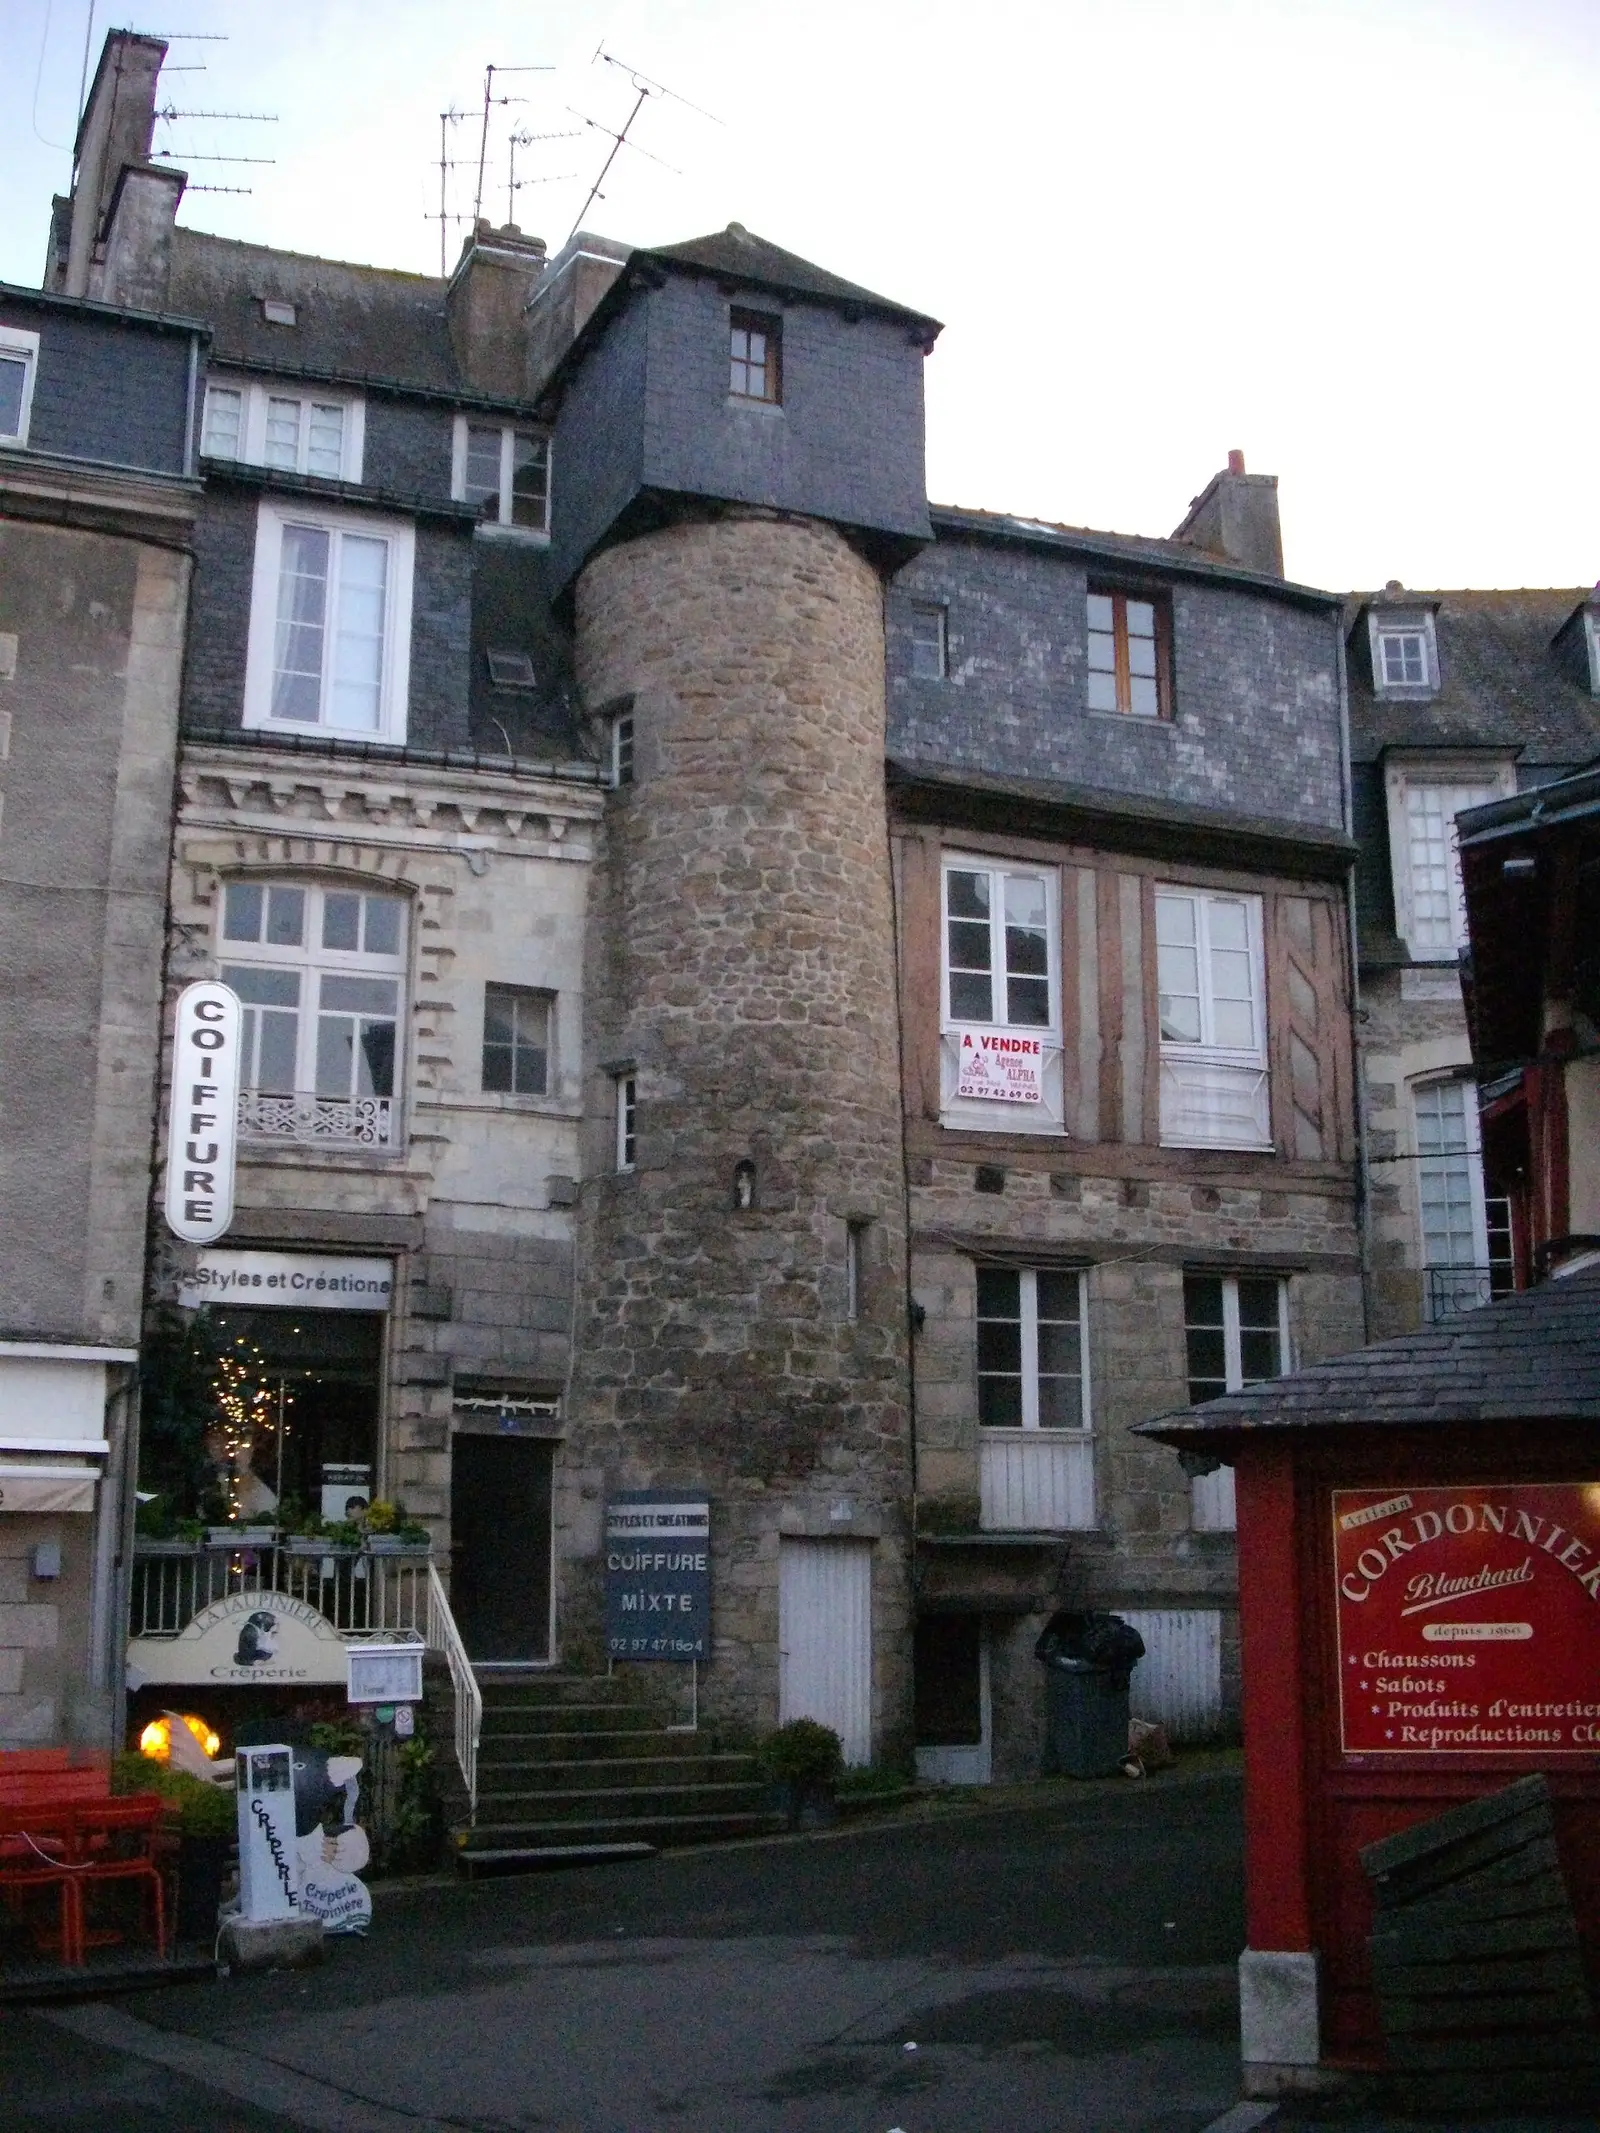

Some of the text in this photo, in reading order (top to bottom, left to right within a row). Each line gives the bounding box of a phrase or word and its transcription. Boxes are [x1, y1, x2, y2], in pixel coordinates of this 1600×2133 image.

[963, 1034, 1040, 1055] A VENDRE
[995, 1053, 1023, 1070] Agence
[1006, 1068, 1035, 1082] ALPHA
[960, 1085, 1039, 1100] 02 97 42 69 00
[184, 1000, 226, 1223] COIFFURE
[199, 1268, 390, 1294] Styles et Créations
[1346, 1499, 1410, 1527] Artisan
[1403, 1556, 1535, 1602] Blanchard
[1434, 1626, 1482, 1641] depuis
[610, 1638, 627, 1651] 02
[632, 1638, 648, 1651] 97
[1363, 1651, 1476, 1668] Chaussons
[1375, 1675, 1446, 1693] Sabots
[1387, 1700, 1479, 1718] Produits
[1401, 1723, 1562, 1748] Reproductions
